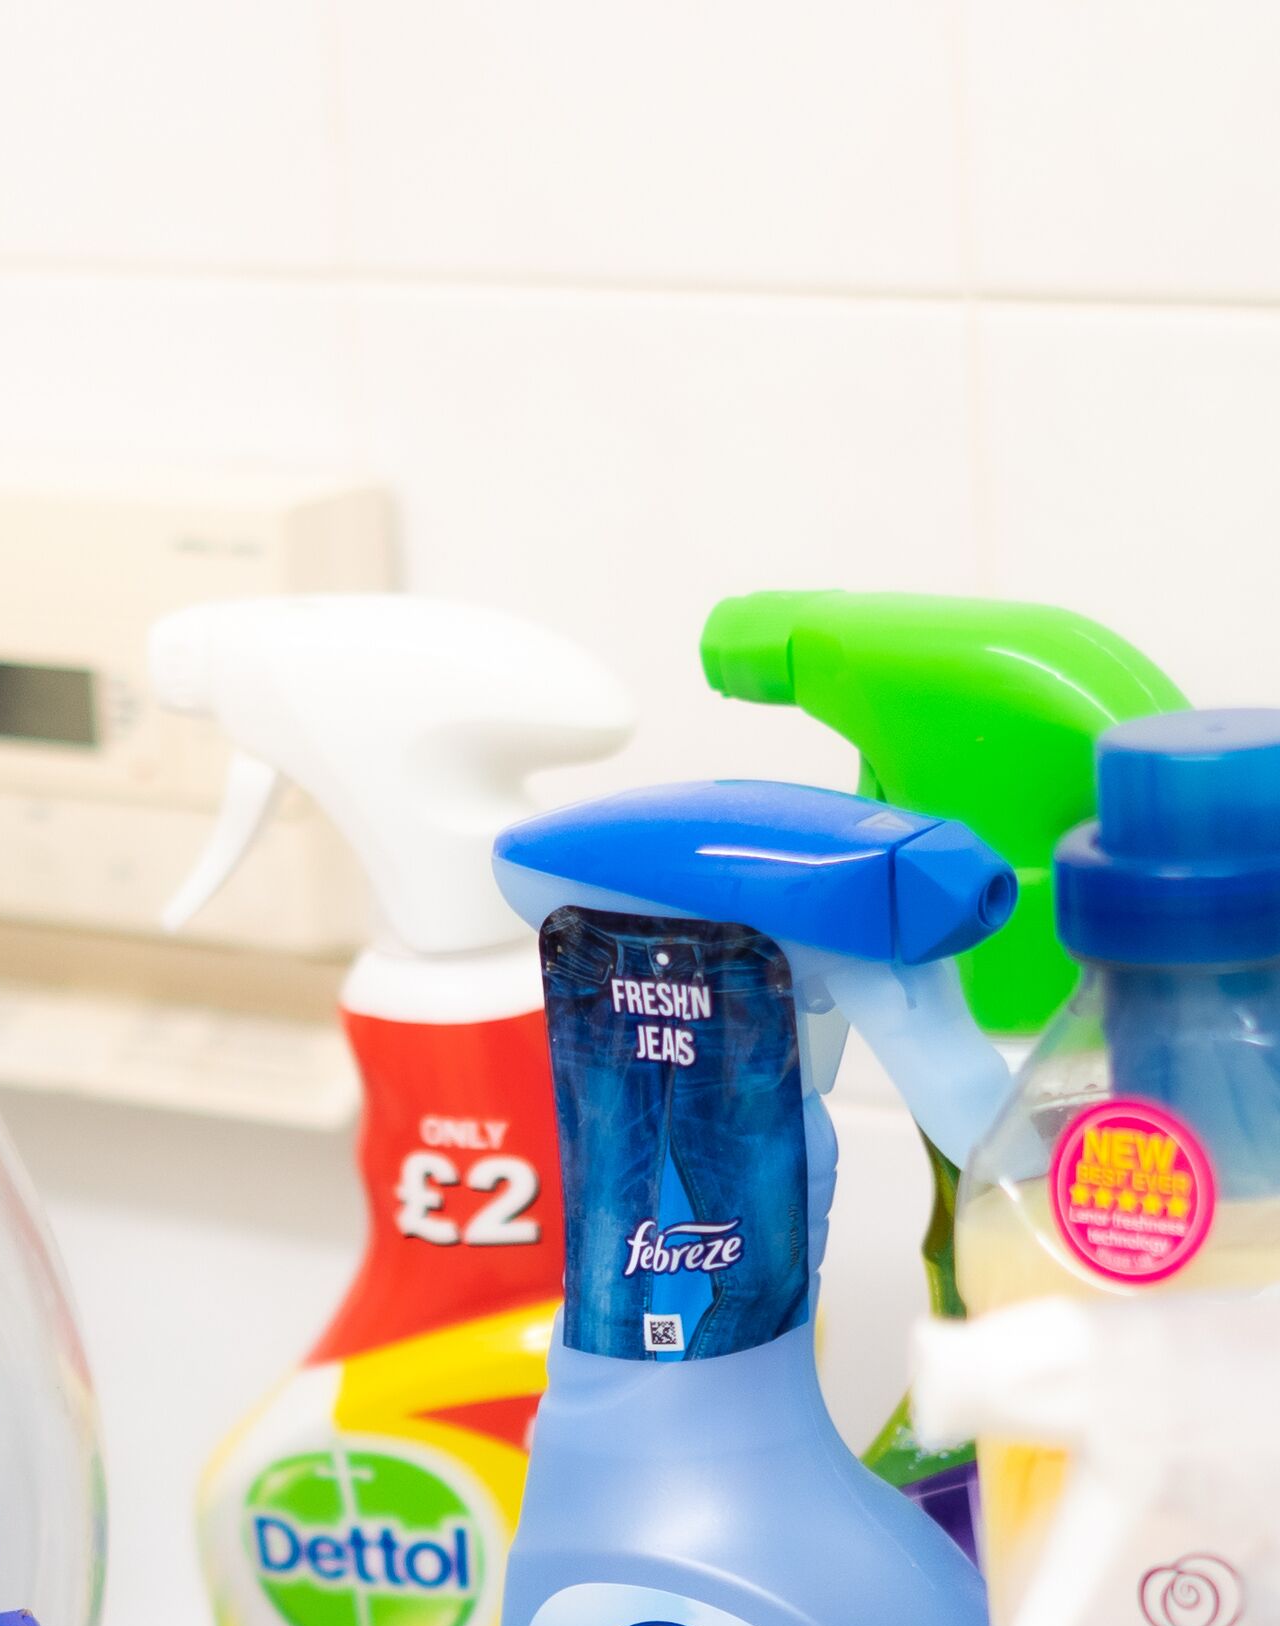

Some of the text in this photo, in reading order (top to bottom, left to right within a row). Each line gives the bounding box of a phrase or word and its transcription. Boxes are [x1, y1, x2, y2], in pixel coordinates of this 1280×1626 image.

[421, 1116, 508, 1150] ONLY
[1082, 1124, 1179, 1172] NEW
[395, 1151, 542, 1246] £2
[624, 1218, 745, 1277] febreze
[252, 1516, 472, 1590] Dettol
